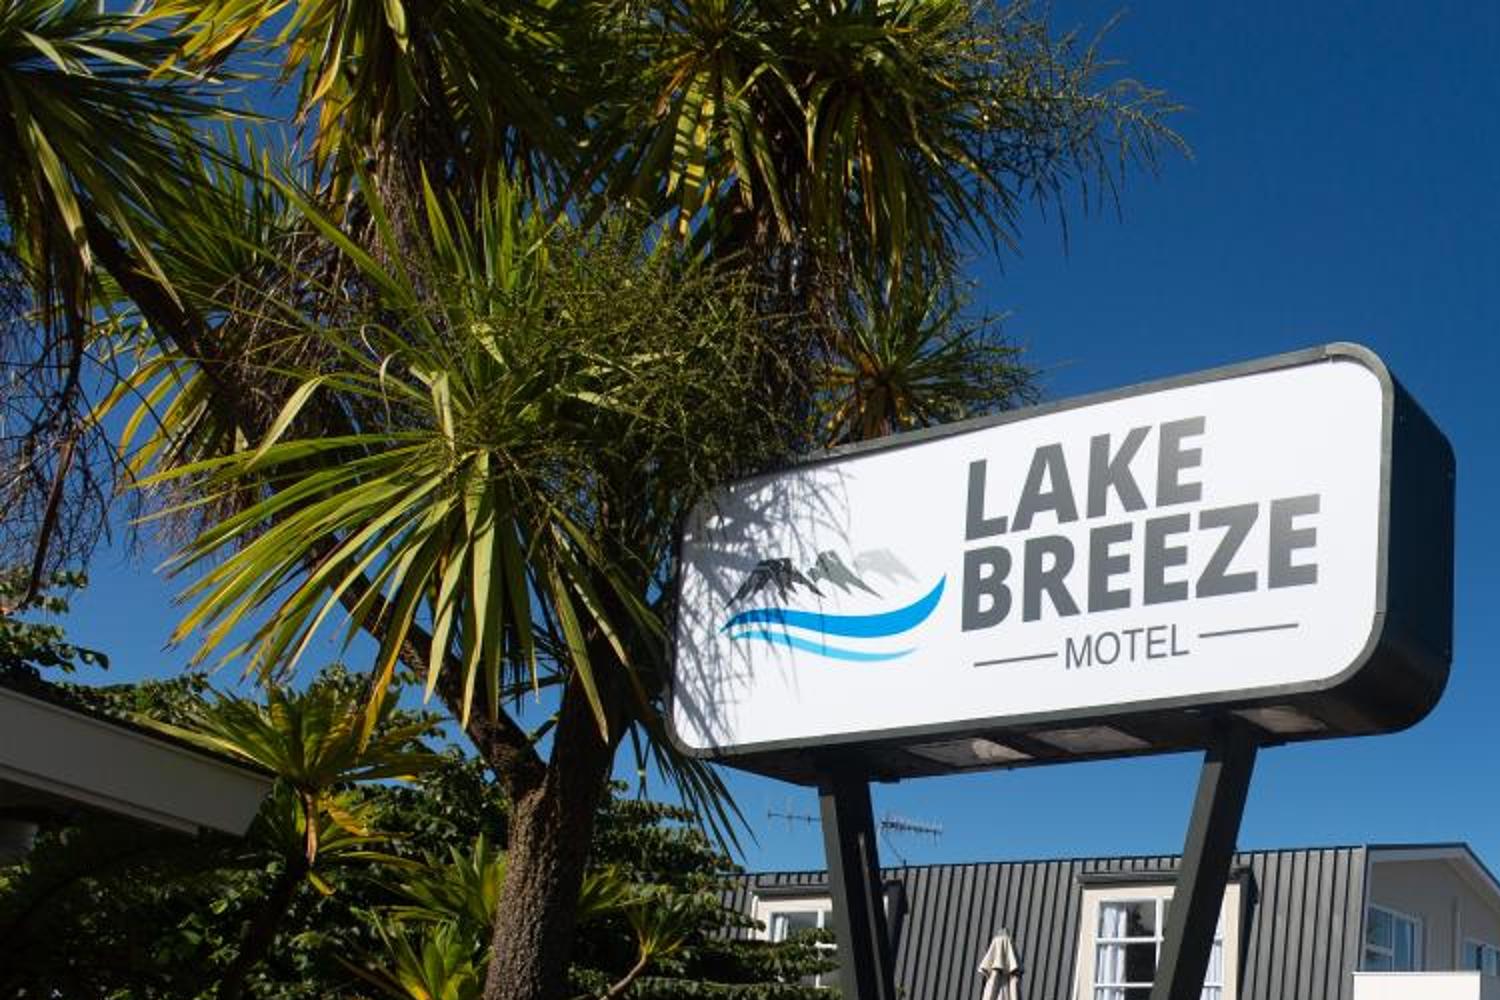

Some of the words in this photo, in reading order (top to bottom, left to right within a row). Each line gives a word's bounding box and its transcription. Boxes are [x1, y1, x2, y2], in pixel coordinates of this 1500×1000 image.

[965, 416, 1206, 541] LAKE
[961, 494, 1320, 632] BREEZE
[1065, 624, 1189, 669] MOTEL
